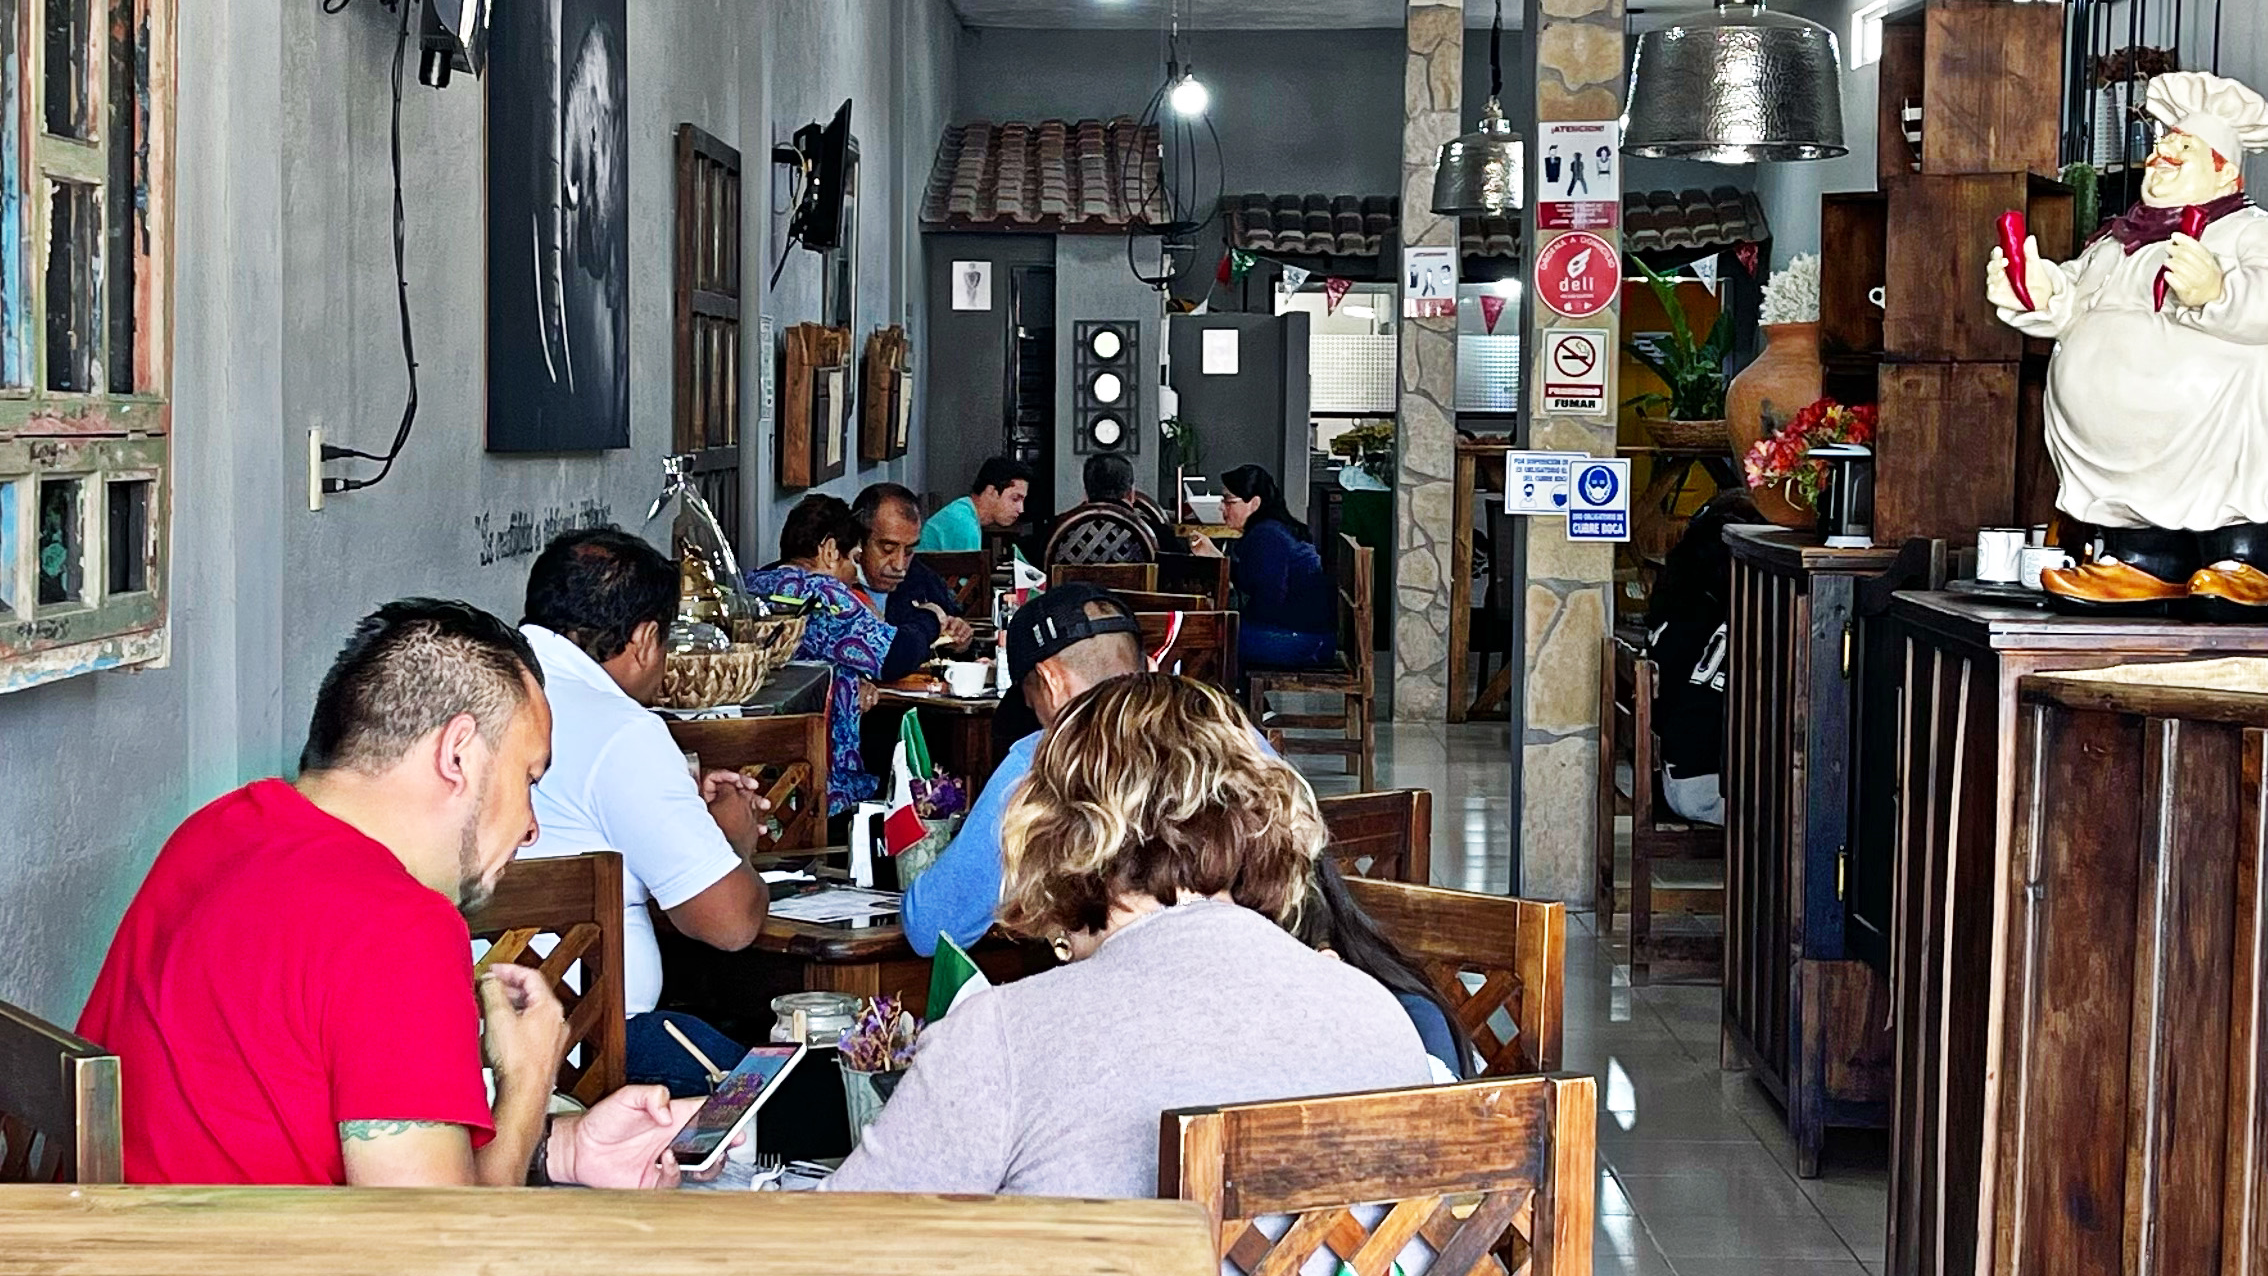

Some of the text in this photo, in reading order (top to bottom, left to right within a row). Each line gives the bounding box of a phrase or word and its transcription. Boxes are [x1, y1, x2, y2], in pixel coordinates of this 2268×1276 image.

[1579, 236, 1616, 269] DOMICILIO
[1558, 276, 1595, 292] deli
[1554, 399, 1596, 409] FUMAR
[1572, 522, 1624, 535] CUBRE BOCA
